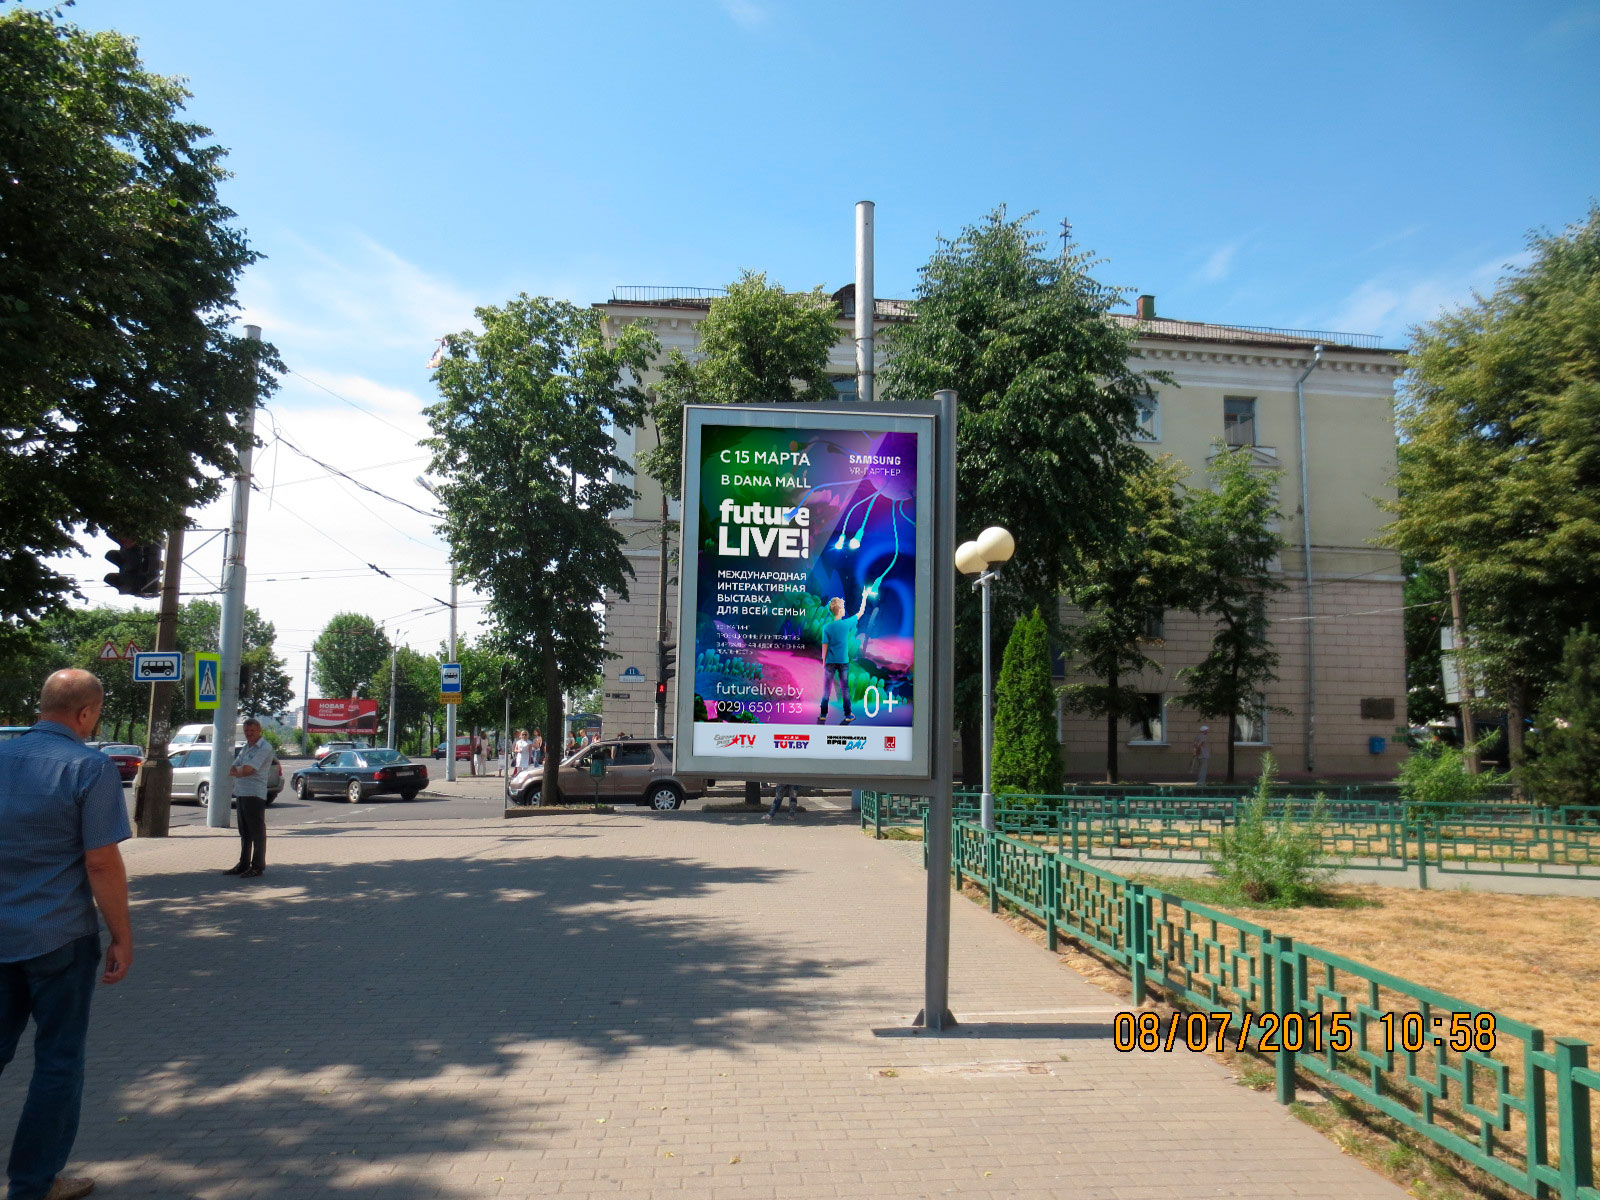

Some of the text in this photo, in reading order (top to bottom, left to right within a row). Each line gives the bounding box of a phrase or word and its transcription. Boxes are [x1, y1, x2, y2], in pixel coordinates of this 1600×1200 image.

[720, 450, 811, 467] С 15 МАРТА
[849, 454, 901, 466] SAMSUNG
[721, 475, 811, 489] В DANA MALL
[719, 498, 810, 527] future
[718, 526, 810, 559] LIVE!
[717, 569, 807, 581] МЕЖДУНАРОДНАЯ
[717, 582, 806, 593] ИНТЕРАКТИВНАЯ
[717, 594, 772, 604] ВЫСТАВКА
[716, 604, 806, 617] ДЛЯ ВСЕЙ СЕМЬИ
[716, 682, 804, 699] futurelive.by
[714, 700, 803, 714] (029) 650 11 33
[863, 685, 899, 718] 0+
[739, 734, 756, 745] TV
[773, 740, 809, 749] TUT.BY
